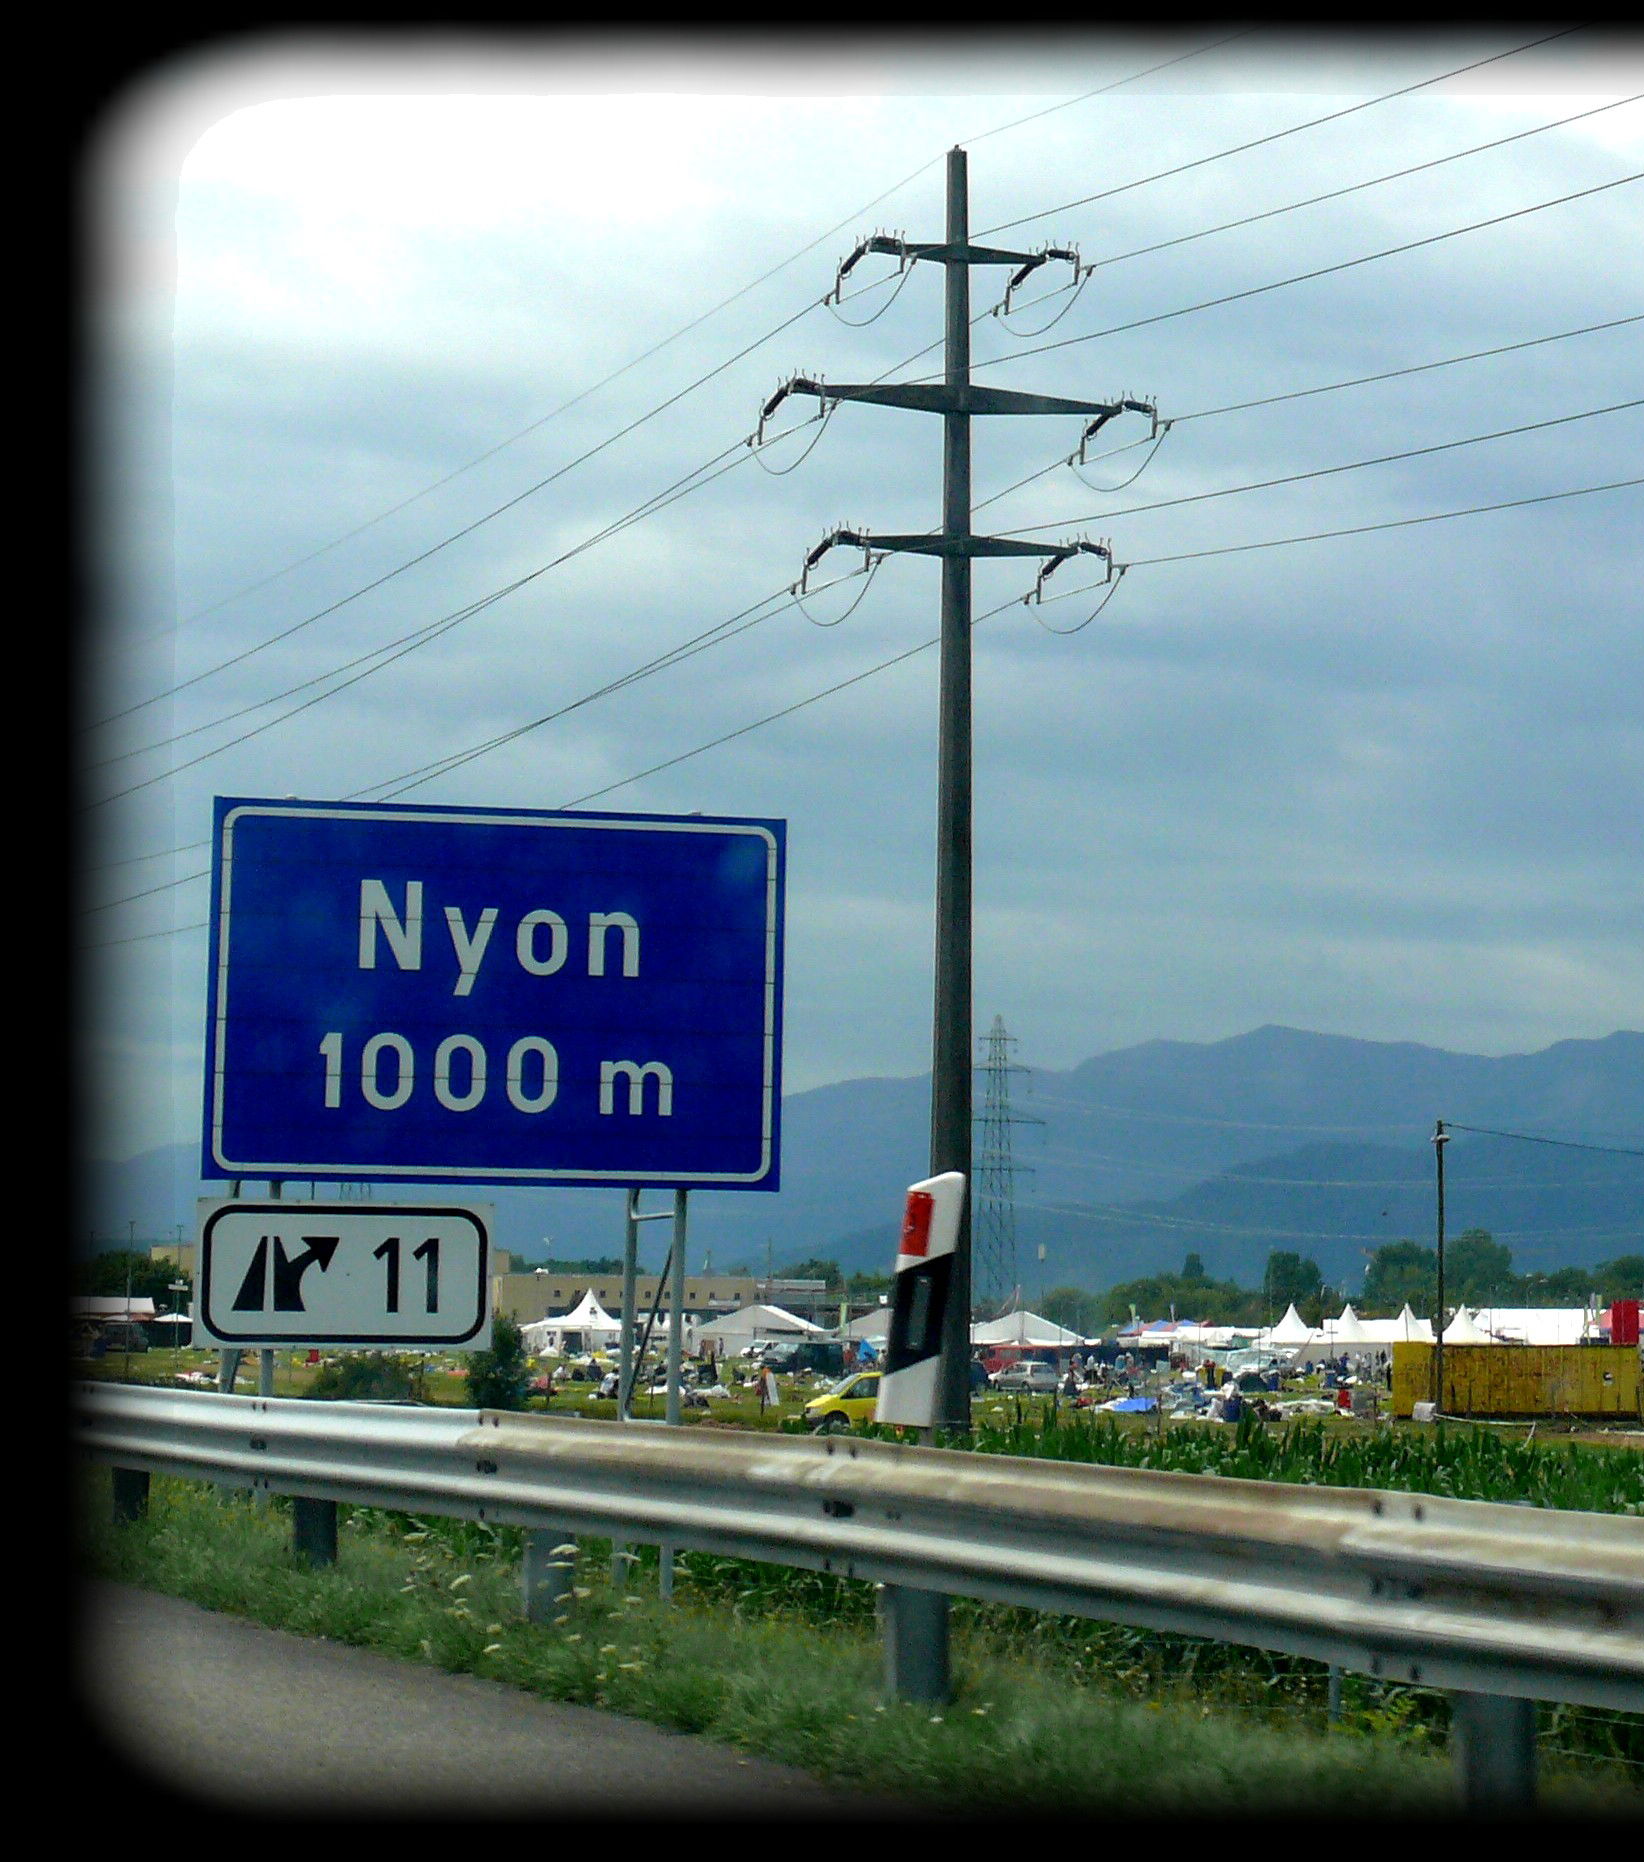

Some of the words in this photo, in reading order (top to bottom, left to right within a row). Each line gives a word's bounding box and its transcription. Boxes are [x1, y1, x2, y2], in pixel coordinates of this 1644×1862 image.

[358, 879, 640, 996] Nyon
[318, 1032, 559, 1114] 1000
[599, 1060, 673, 1116] m
[372, 1237, 440, 1314] 11
